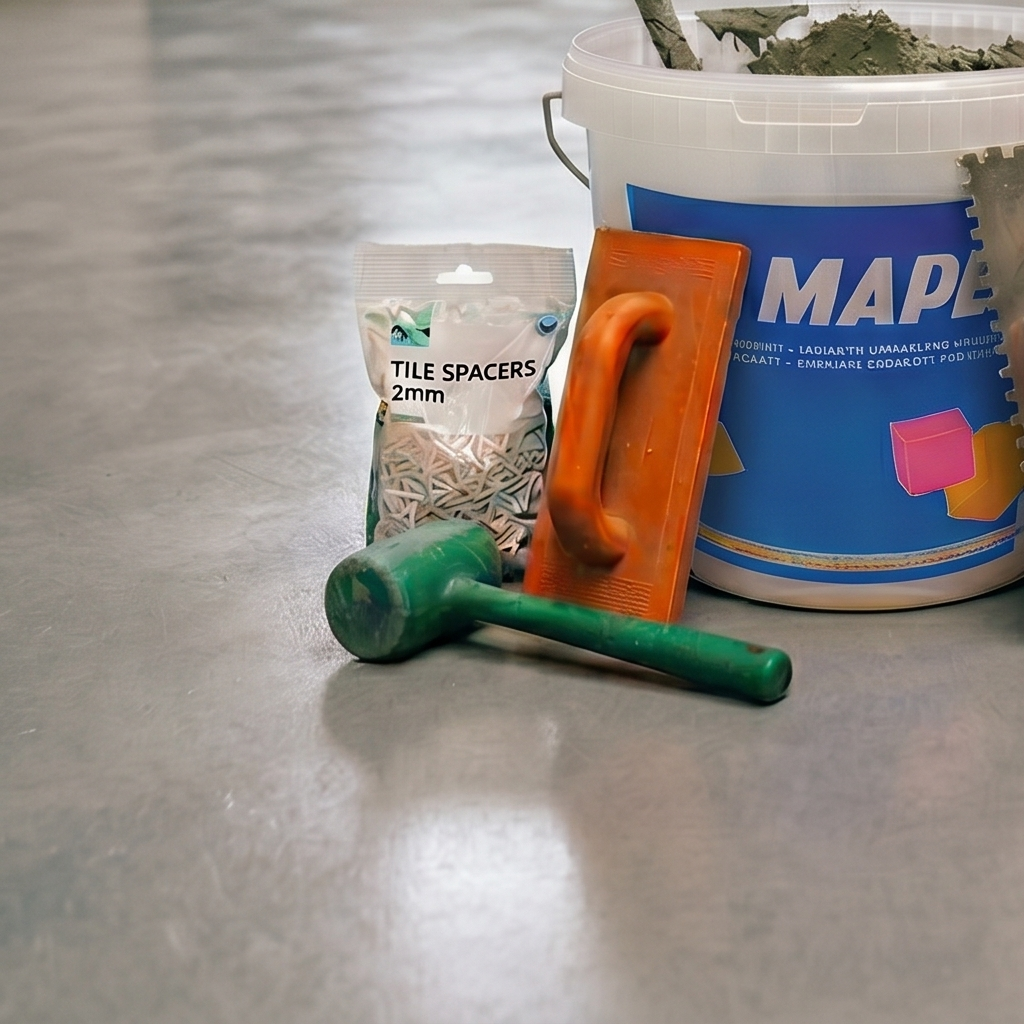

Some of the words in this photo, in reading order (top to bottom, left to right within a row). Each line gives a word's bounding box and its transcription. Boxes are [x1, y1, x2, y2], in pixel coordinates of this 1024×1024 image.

[390, 360, 435, 381] TILE
[442, 360, 537, 381] SPACERS
[391, 384, 445, 403] 2mm
